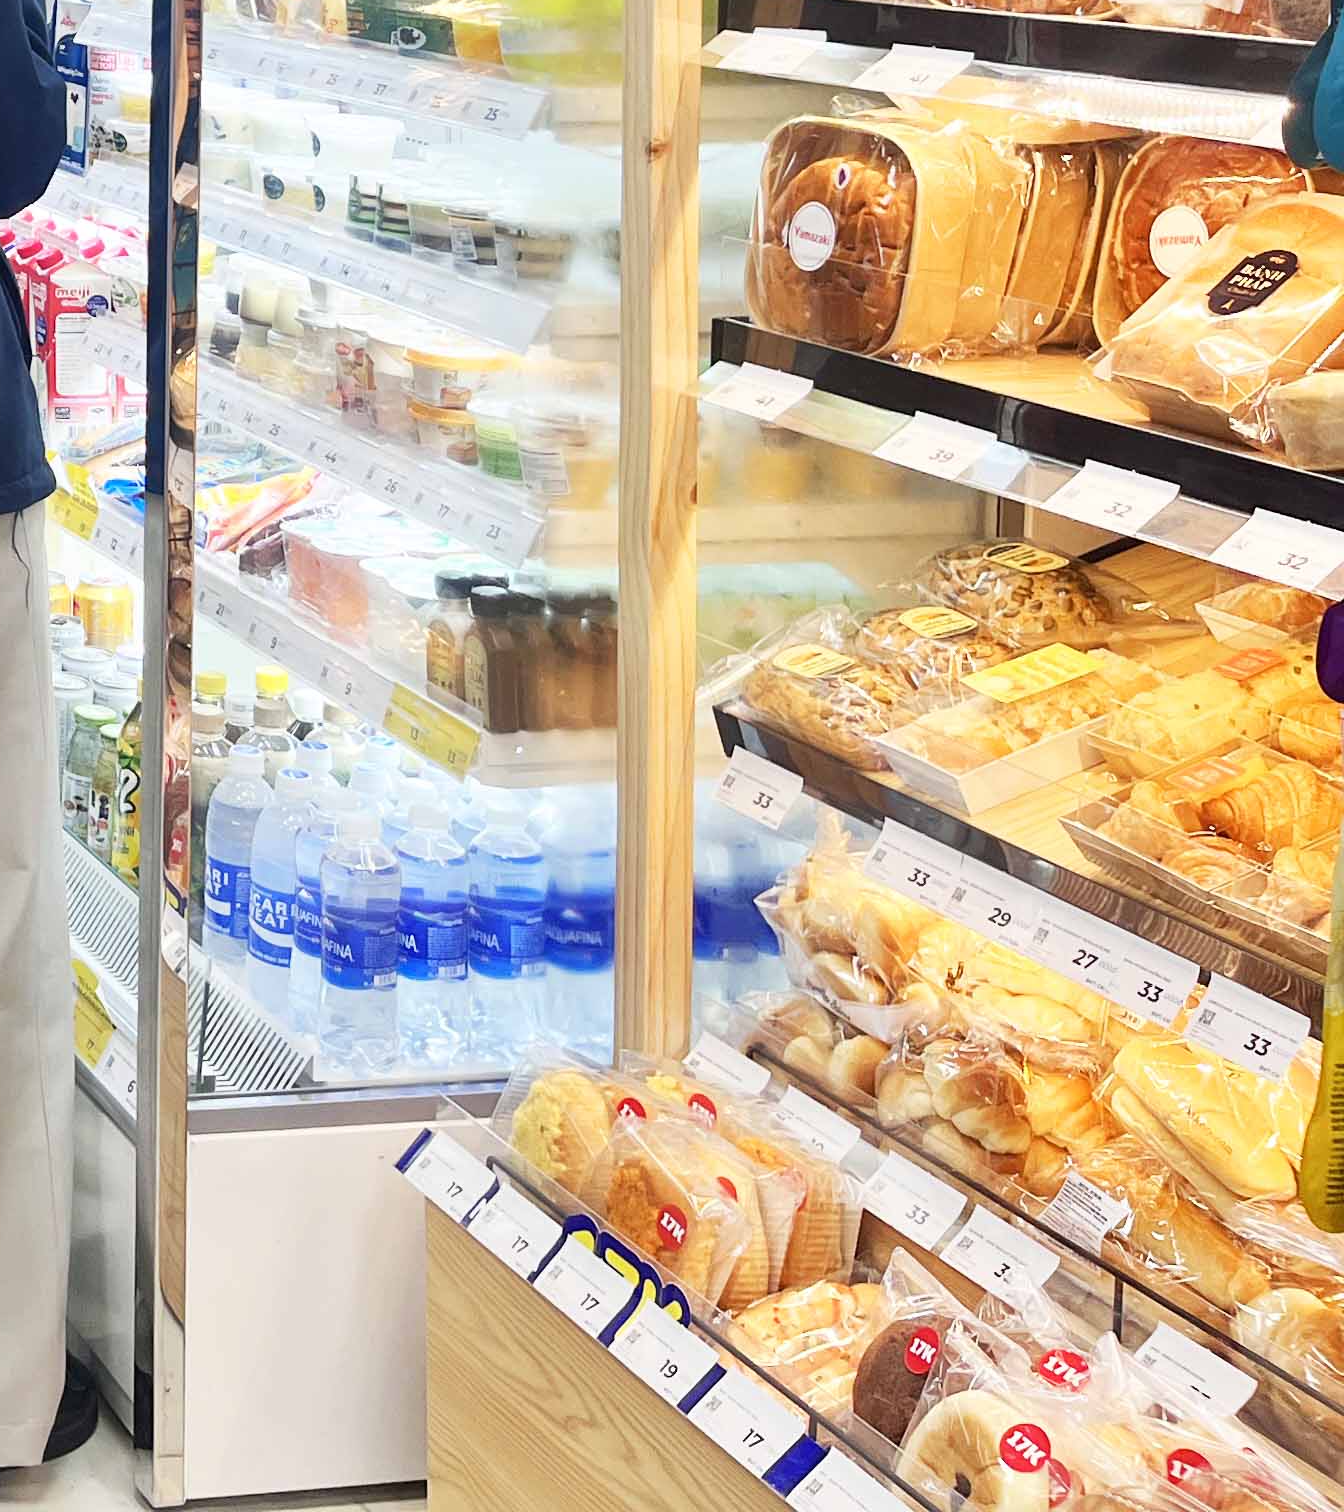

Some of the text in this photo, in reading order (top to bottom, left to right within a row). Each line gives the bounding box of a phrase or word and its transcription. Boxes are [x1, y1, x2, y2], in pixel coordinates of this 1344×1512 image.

[793, 228, 832, 246] Yamazaki
[1240, 263, 1286, 281] BÁNH
[55, 284, 91, 298] meiji
[928, 448, 955, 464] 39
[1104, 501, 1133, 518] 32
[1276, 552, 1309, 571] 32
[752, 790, 774, 809] 33
[907, 867, 931, 886] 33
[987, 907, 1012, 926] 29
[1072, 949, 1100, 969] 27
[1137, 980, 1165, 1004] 33
[1243, 1032, 1273, 1057] 33
[127, 1079, 137, 1093] 6
[447, 1180, 463, 1199] 17
[905, 1203, 931, 1225] 33
[659, 1212, 686, 1244] 17K
[511, 1235, 528, 1253] 17
[580, 1292, 599, 1311] 17
[908, 1336, 937, 1365] 17K
[658, 1358, 679, 1378] 19
[1043, 1352, 1091, 1388] 17K
[742, 1428, 765, 1448] 17
[1003, 1429, 1048, 1467] 17K
